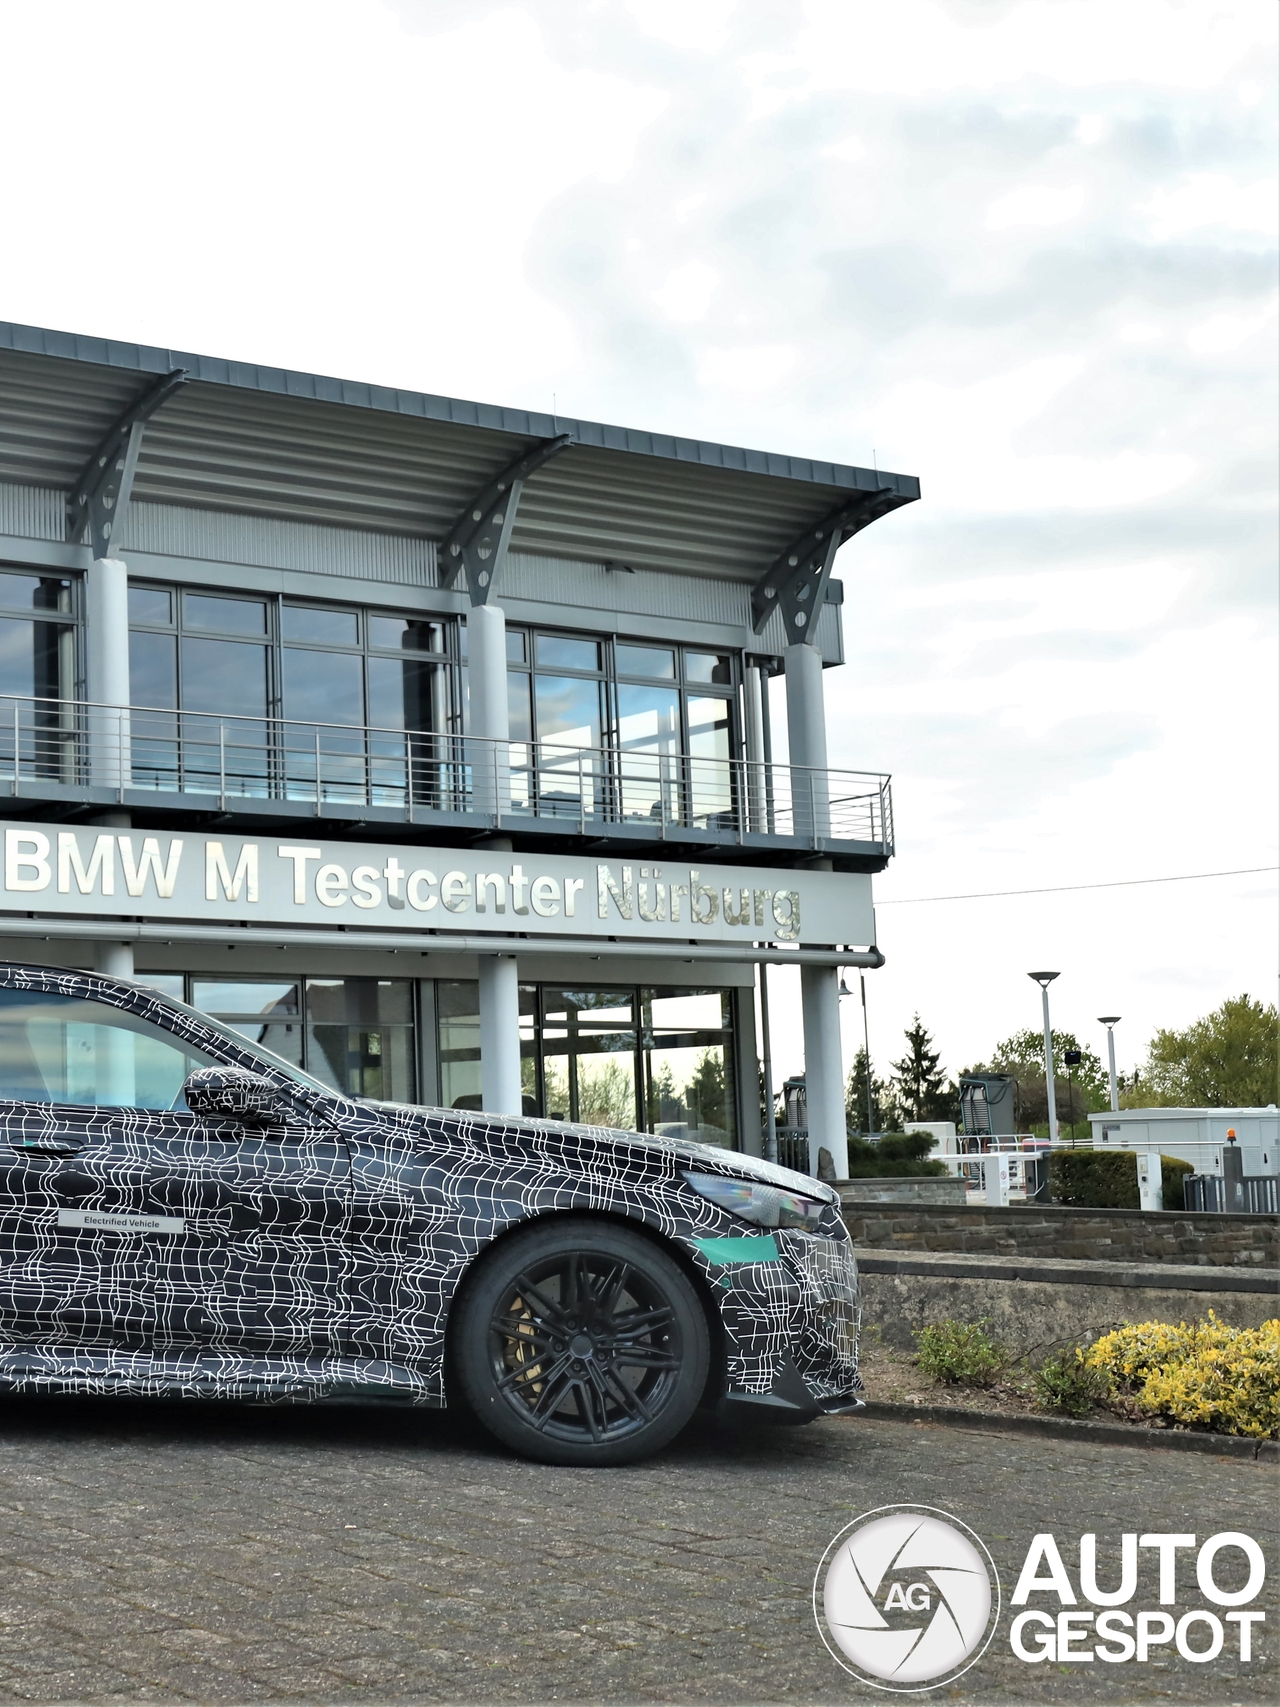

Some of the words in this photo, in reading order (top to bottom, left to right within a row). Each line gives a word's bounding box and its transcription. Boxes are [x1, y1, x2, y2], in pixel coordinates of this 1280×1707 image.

[4, 828, 183, 899] BMW
[205, 841, 259, 903] M
[277, 845, 585, 918] Testcenter
[596, 863, 802, 941] Nürburg
[84, 1215, 127, 1226] Electrified
[128, 1219, 160, 1229] Vehicle
